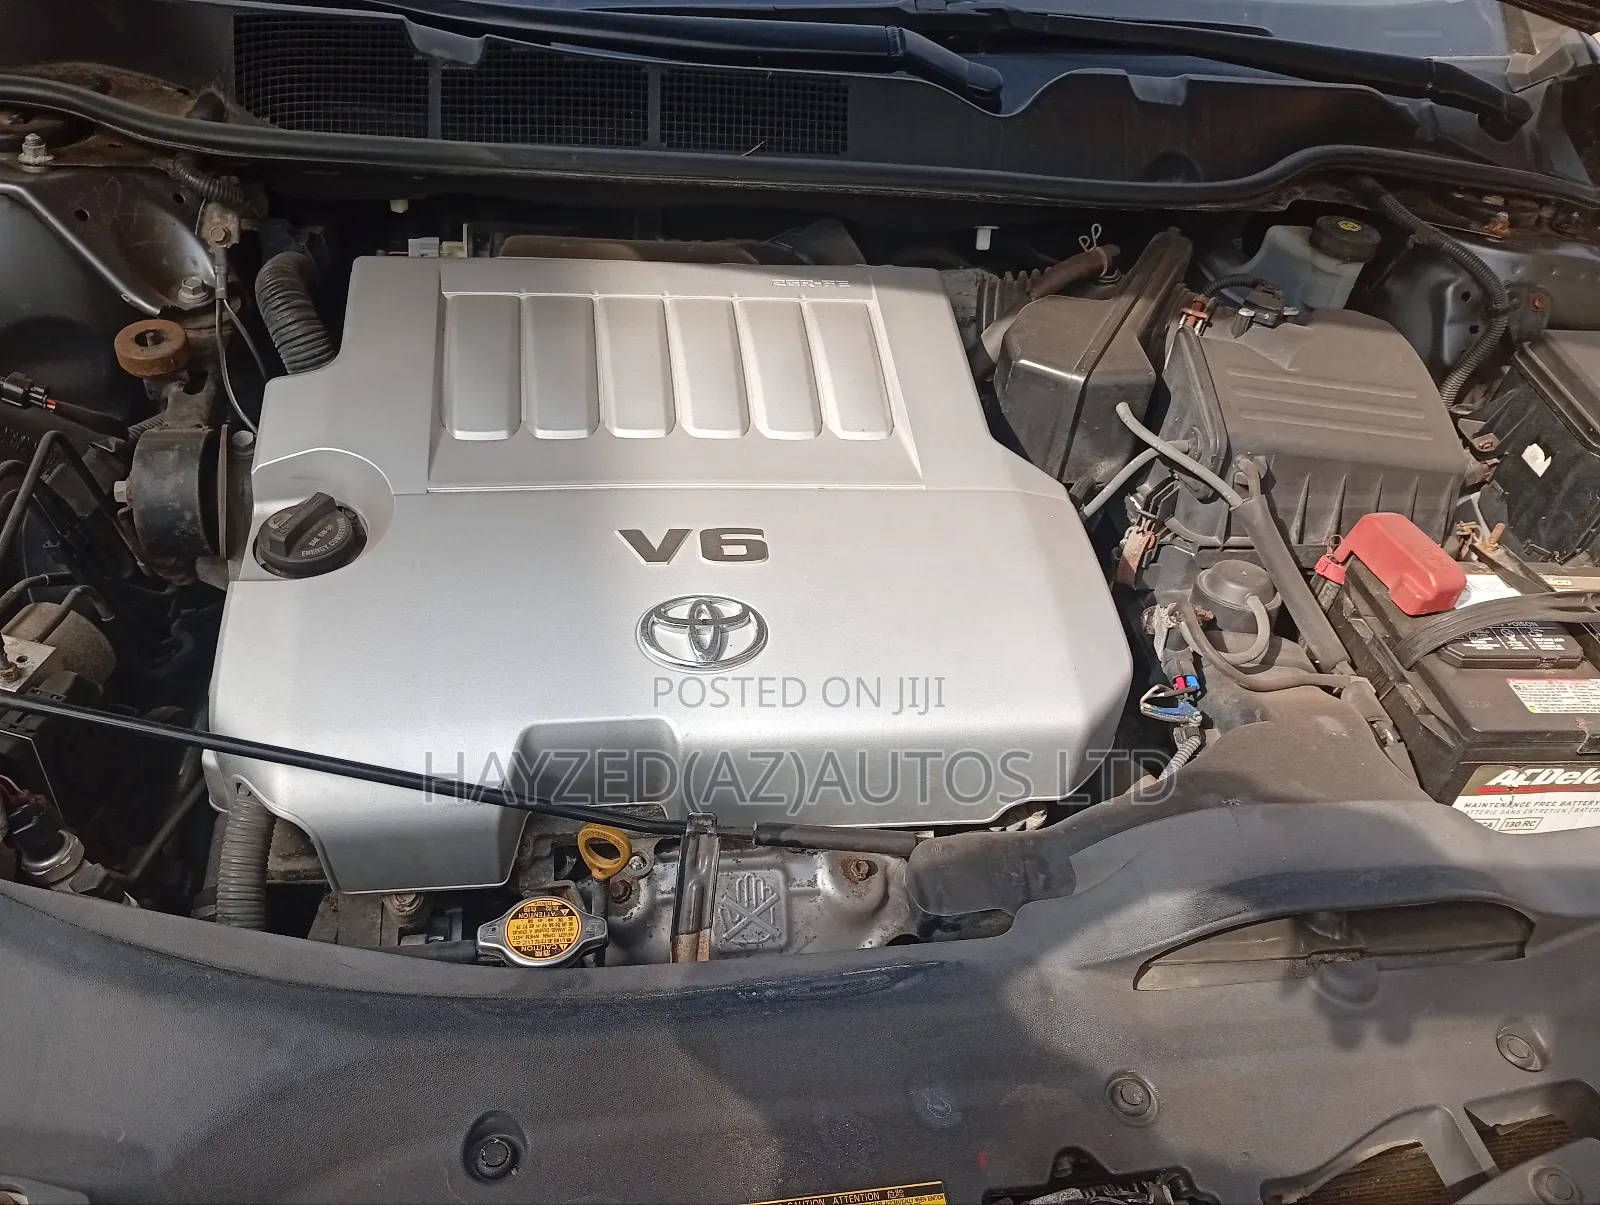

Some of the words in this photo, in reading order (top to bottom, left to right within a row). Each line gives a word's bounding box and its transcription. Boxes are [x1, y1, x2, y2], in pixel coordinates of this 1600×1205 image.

[308, 537, 320, 546] SAE
[614, 527, 769, 566] V6
[302, 544, 328, 556] ENERGY
[1484, 767, 1600, 788] ACDelc
[832, 1191, 880, 1205] ATTENTION
